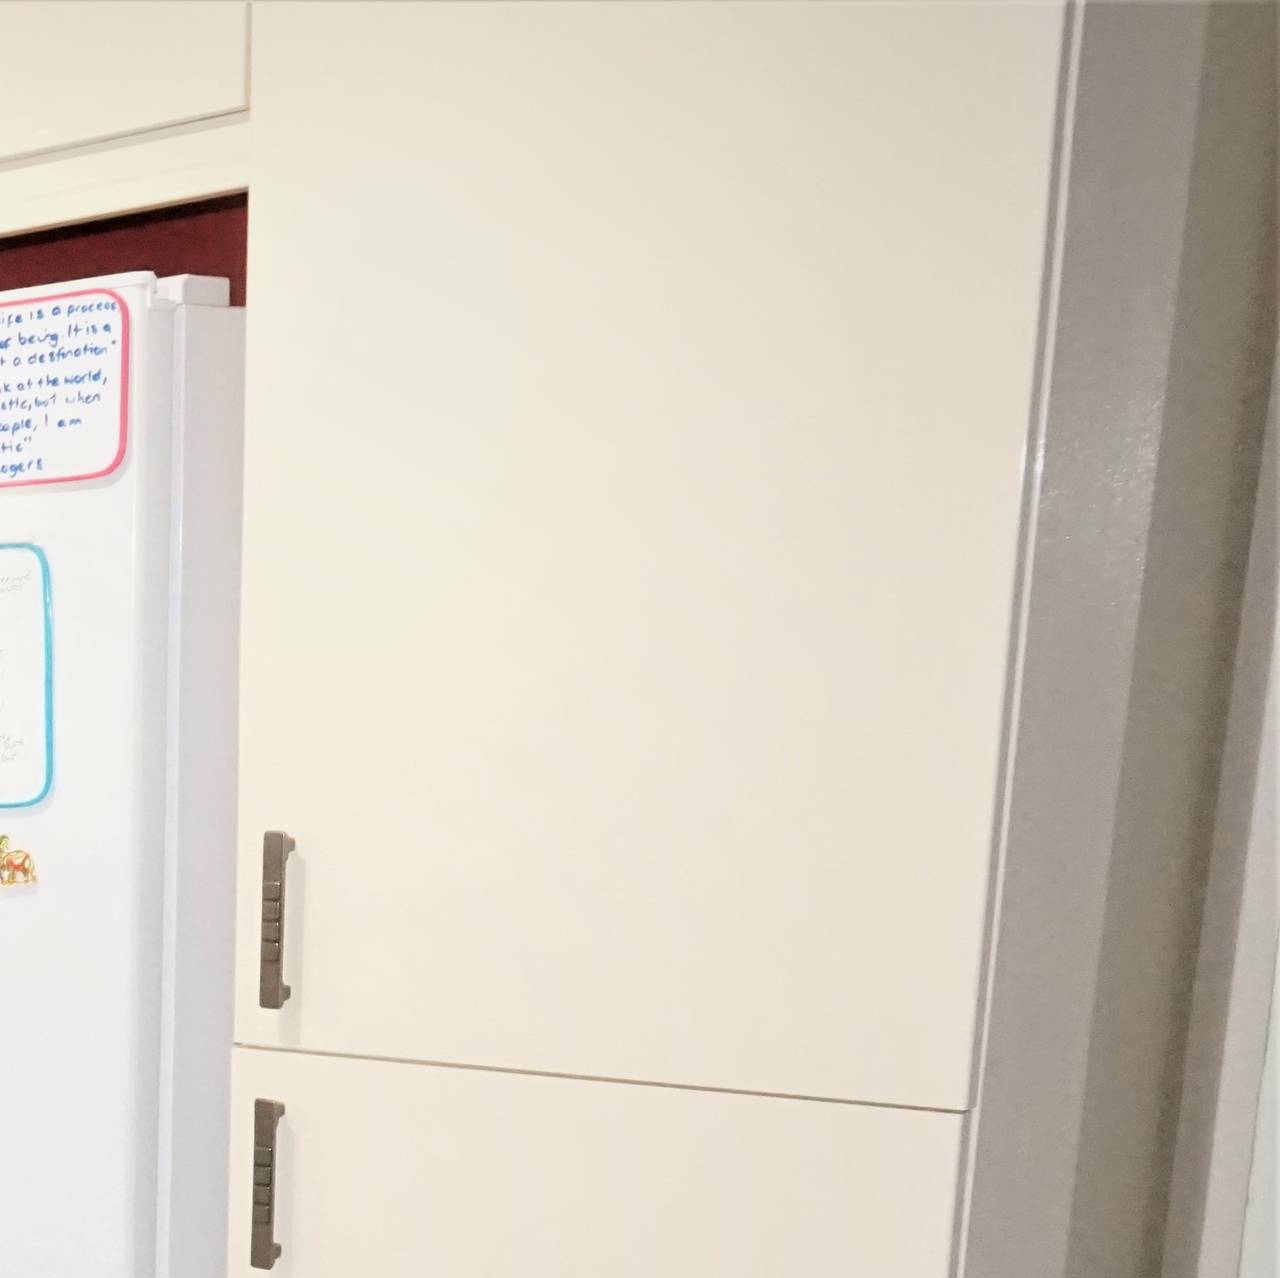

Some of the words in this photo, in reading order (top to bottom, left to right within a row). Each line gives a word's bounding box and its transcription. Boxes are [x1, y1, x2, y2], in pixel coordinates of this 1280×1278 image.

[51, 306, 62, 317] a
[13, 357, 22, 367] a
[17, 378, 34, 392] at
[38, 374, 60, 388] the
[57, 418, 83, 428] am
